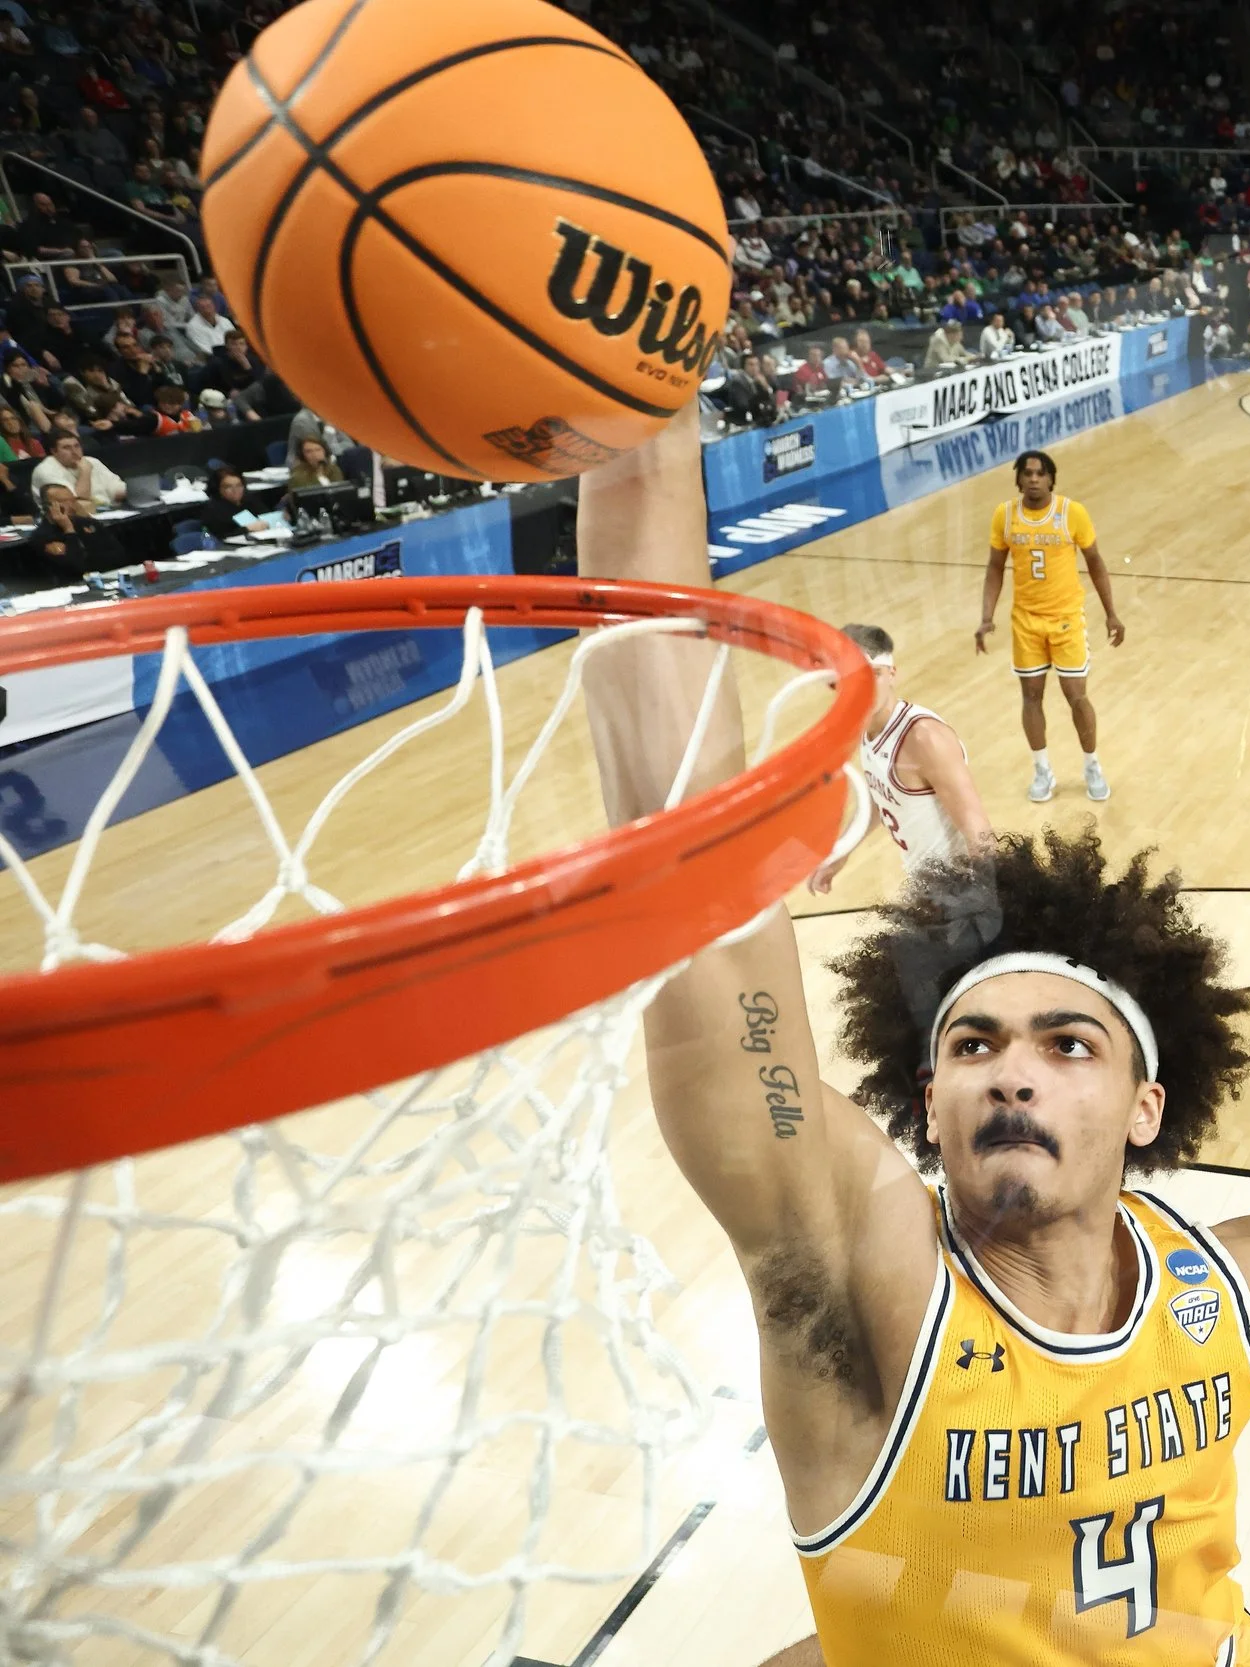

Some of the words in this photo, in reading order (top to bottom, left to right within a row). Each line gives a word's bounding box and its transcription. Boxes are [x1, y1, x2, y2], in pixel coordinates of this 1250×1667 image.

[547, 216, 719, 377] Wilso
[933, 377, 977, 428] MAAC
[982, 369, 1018, 411] AND
[1020, 357, 1059, 400] SIENA
[1062, 343, 1111, 388] COLLEGE
[1030, 548, 1046, 580] 2
[738, 991, 779, 1054] Big
[759, 1065, 804, 1139] Fella
[1175, 1264, 1209, 1277] NCAA
[1177, 1301, 1219, 1326] MAC
[945, 1420, 1082, 1502] KENT
[1104, 1371, 1231, 1480] STATE
[1068, 1495, 1165, 1639] 4
